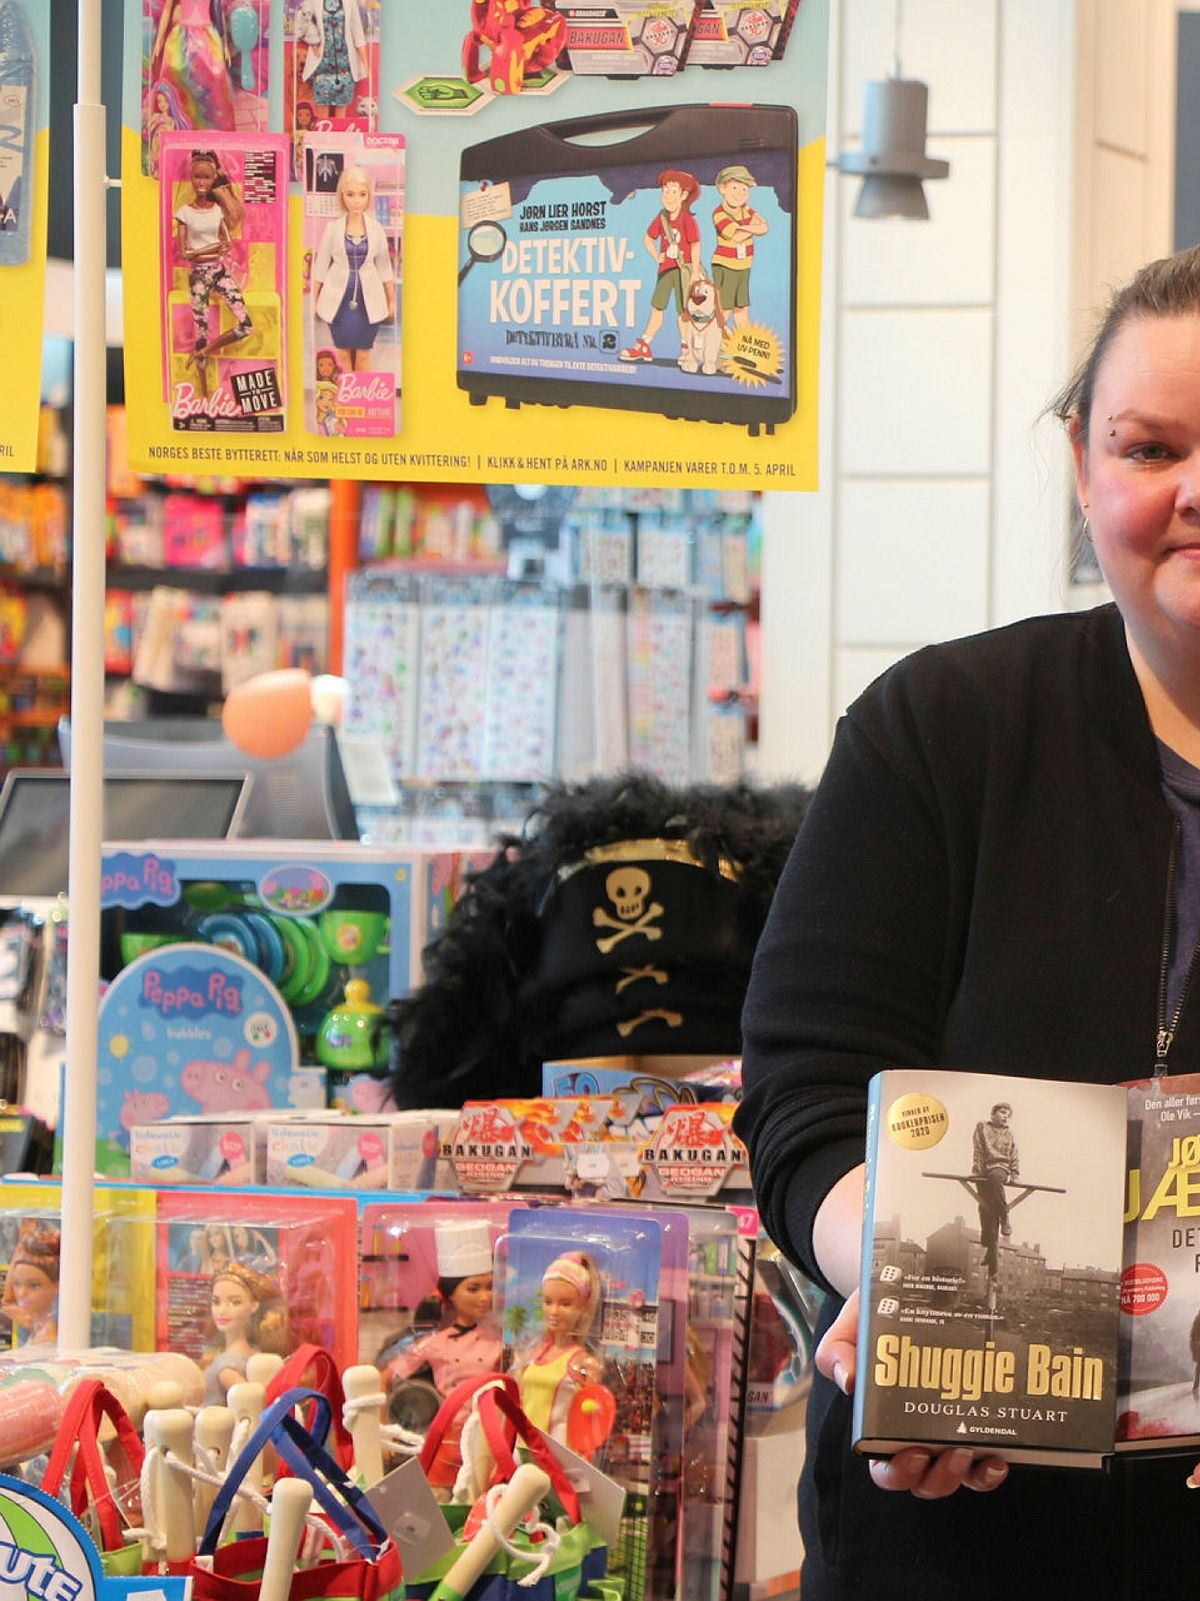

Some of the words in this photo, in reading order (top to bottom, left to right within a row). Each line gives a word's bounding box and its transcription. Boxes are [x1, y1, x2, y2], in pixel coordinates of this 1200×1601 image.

[569, 30, 625, 45] BAKUGAN
[520, 205, 546, 220] JØRN
[549, 204, 569, 219] LIER
[572, 201, 607, 217] HORST
[570, 218, 606, 231] SANDNES
[502, 236, 635, 275] DETEKTIV-
[490, 278, 641, 328] KOFFERT
[236, 369, 273, 390] MADE
[337, 373, 394, 402] Barbie
[173, 382, 241, 419] Barbie
[241, 391, 278, 414] MOVE
[0, 445, 15, 458] RIL
[149, 446, 188, 459] NORGES
[192, 448, 222, 460] BESTE
[284, 447, 304, 463] NÅR
[308, 452, 328, 464] SOM
[332, 452, 362, 465] HELST
[365, 453, 378, 466] OG
[382, 453, 406, 466] UTEN
[410, 454, 471, 468] KVITTERING!
[487, 456, 515, 469] KLIKK
[527, 457, 551, 470] HENT
[556, 455, 569, 471] PÅ
[624, 459, 683, 475] KAMPANJEN
[686, 461, 718, 475] VARER
[721, 462, 750, 476] T.O.M.
[753, 462, 763, 476] 5.
[766, 463, 796, 477] APRIL
[144, 857, 175, 897] Pig
[144, 969, 206, 1014] Peppa
[208, 972, 243, 1014] Pig
[167, 1025, 211, 1041] bubbles
[1145, 1099, 1162, 1111] Den
[1164, 1097, 1184, 1109] aller
[1160, 1111, 1175, 1122] Ole
[1177, 1109, 1191, 1120] Vik
[911, 1126, 930, 1138] 2020
[443, 1144, 531, 1157] BAKUGAN
[645, 1149, 741, 1161] BAKUGAN
[658, 1167, 725, 1177] GEOGAN
[874, 1334, 1015, 1401] Shuggie
[1027, 1343, 1103, 1401] Bain
[904, 1402, 990, 1418] DOUGLAS
[997, 1407, 1068, 1423] STUART
[969, 1426, 1018, 1436] GYLDENDAL
